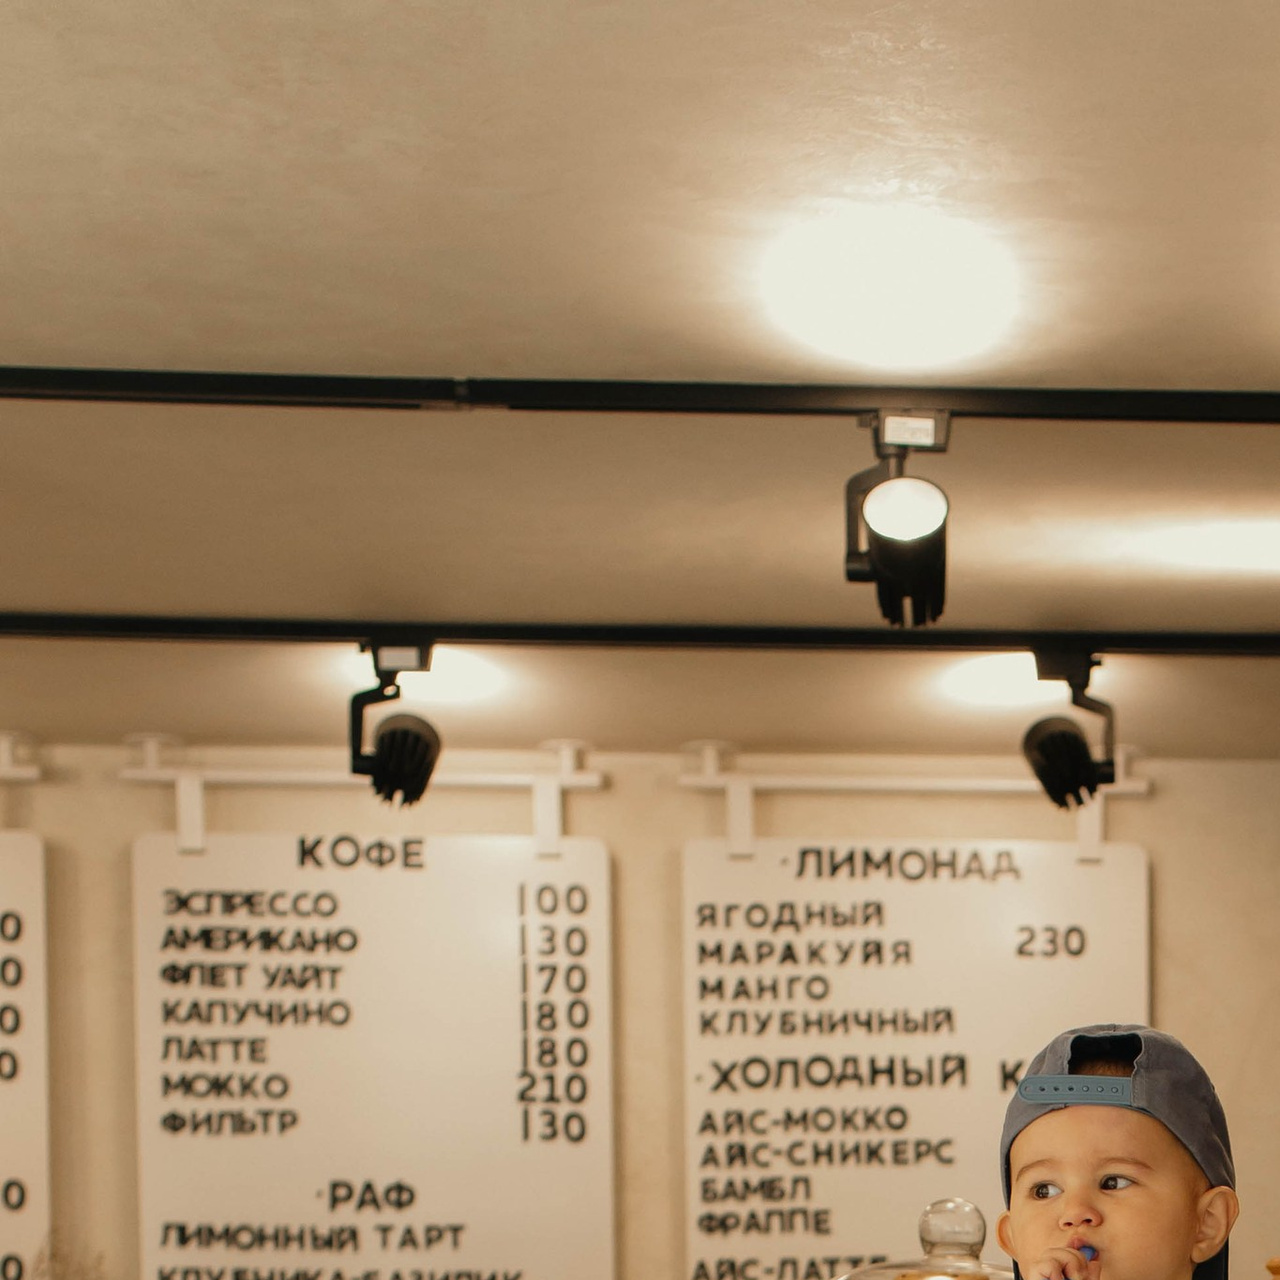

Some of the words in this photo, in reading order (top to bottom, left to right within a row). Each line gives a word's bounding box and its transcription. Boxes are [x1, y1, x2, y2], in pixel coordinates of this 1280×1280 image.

[297, 833, 424, 869] КОФЕ
[795, 847, 1021, 882] ЛИМОНАД
[162, 889, 338, 918] ЭСПРЕССО
[519, 883, 590, 918] 100
[697, 902, 883, 933] ЯГОДНЫЙ
[162, 927, 357, 952] АМЕРИКАНО
[521, 925, 588, 959] 130
[699, 941, 910, 964] МАРАКУЙЯ
[1017, 926, 1086, 958] 230
[161, 963, 246, 987] ФЛЕТ
[263, 965, 341, 990] УАЙТ
[521, 962, 588, 994] 170
[699, 976, 829, 1000] МАНГО
[162, 1000, 350, 1026] КАПУЧИНО
[522, 1000, 589, 1032] 180
[701, 1009, 953, 1035] КЛУБНИЧНЫЙ
[162, 1036, 265, 1063] ЛАТТЕ
[522, 1035, 589, 1070] 180
[162, 1074, 289, 1099] МОККО
[517, 1072, 588, 1104] 210
[712, 1055, 966, 1092] ХОЛОДНЫЙ
[161, 1110, 297, 1134] ФИЛЬТР
[522, 1107, 587, 1142] 130
[699, 1106, 908, 1135] АЙС-МОККО
[701, 1140, 953, 1168] АЙС-СНИКЕРС
[330, 1181, 415, 1211] РАФ
[702, 1177, 810, 1203] БАМБЛ
[162, 1224, 358, 1251] ЛИМОННЫЙ
[376, 1225, 464, 1250] ТАРТ
[698, 1208, 830, 1235] ФРАППЕ
